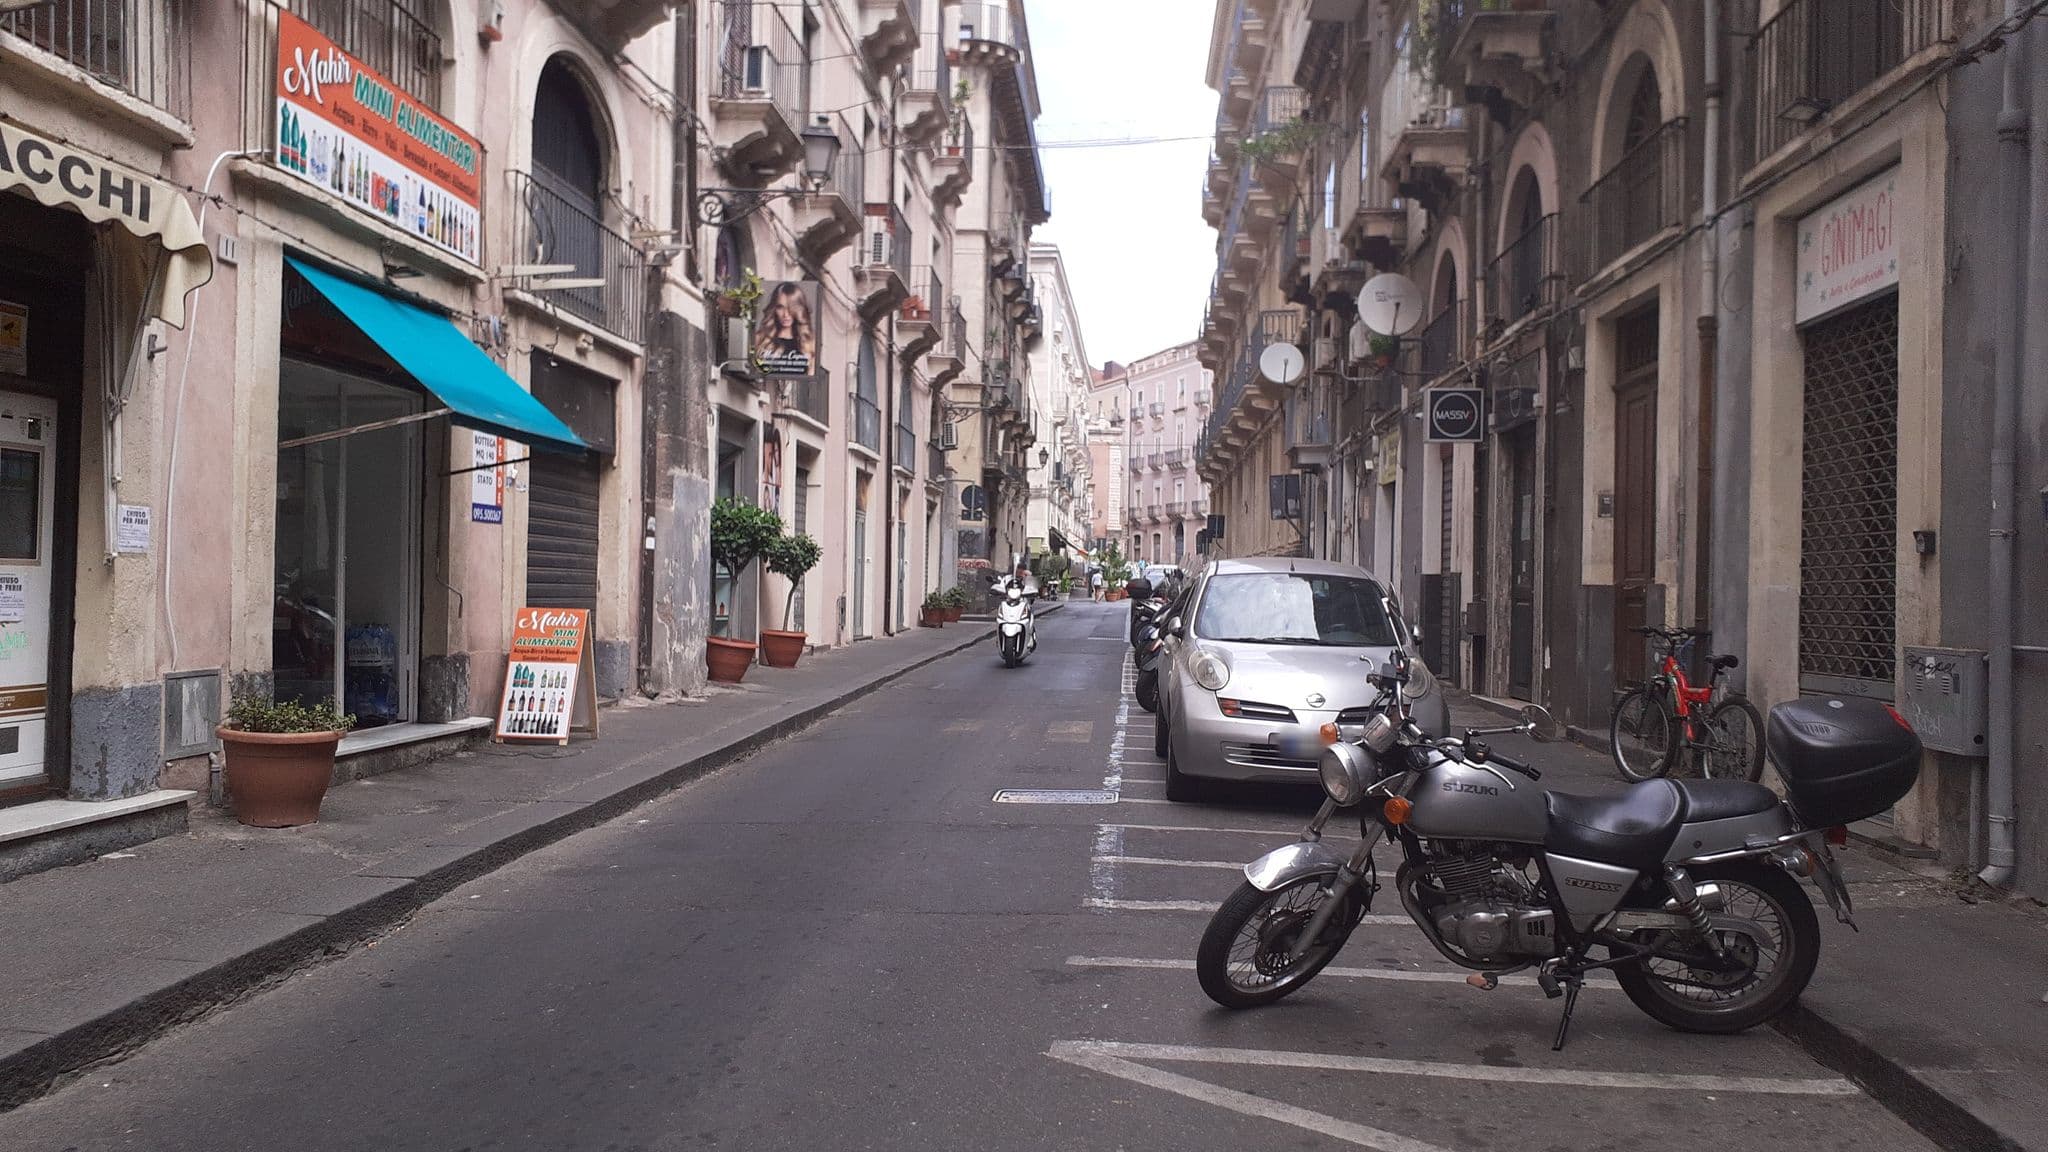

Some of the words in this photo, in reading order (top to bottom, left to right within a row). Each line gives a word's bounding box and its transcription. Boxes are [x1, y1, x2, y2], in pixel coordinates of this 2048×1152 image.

[283, 46, 351, 104] Mahir
[353, 69, 394, 123] MINI
[396, 98, 477, 177] ALIMENTARI
[1821, 191, 1893, 276] GINIMAGI
[474, 435, 496, 448] BOTTEGA
[476, 448, 485, 459] MQ
[477, 475, 493, 486] STATO
[126, 510, 146, 518] CHIUSO
[518, 610, 579, 633] Mahir
[553, 629, 578, 637] MINI
[515, 638, 577, 648] ALIMENTARI
[1442, 782, 1498, 796] SUZUKI
[1565, 877, 1622, 892] TU250X
